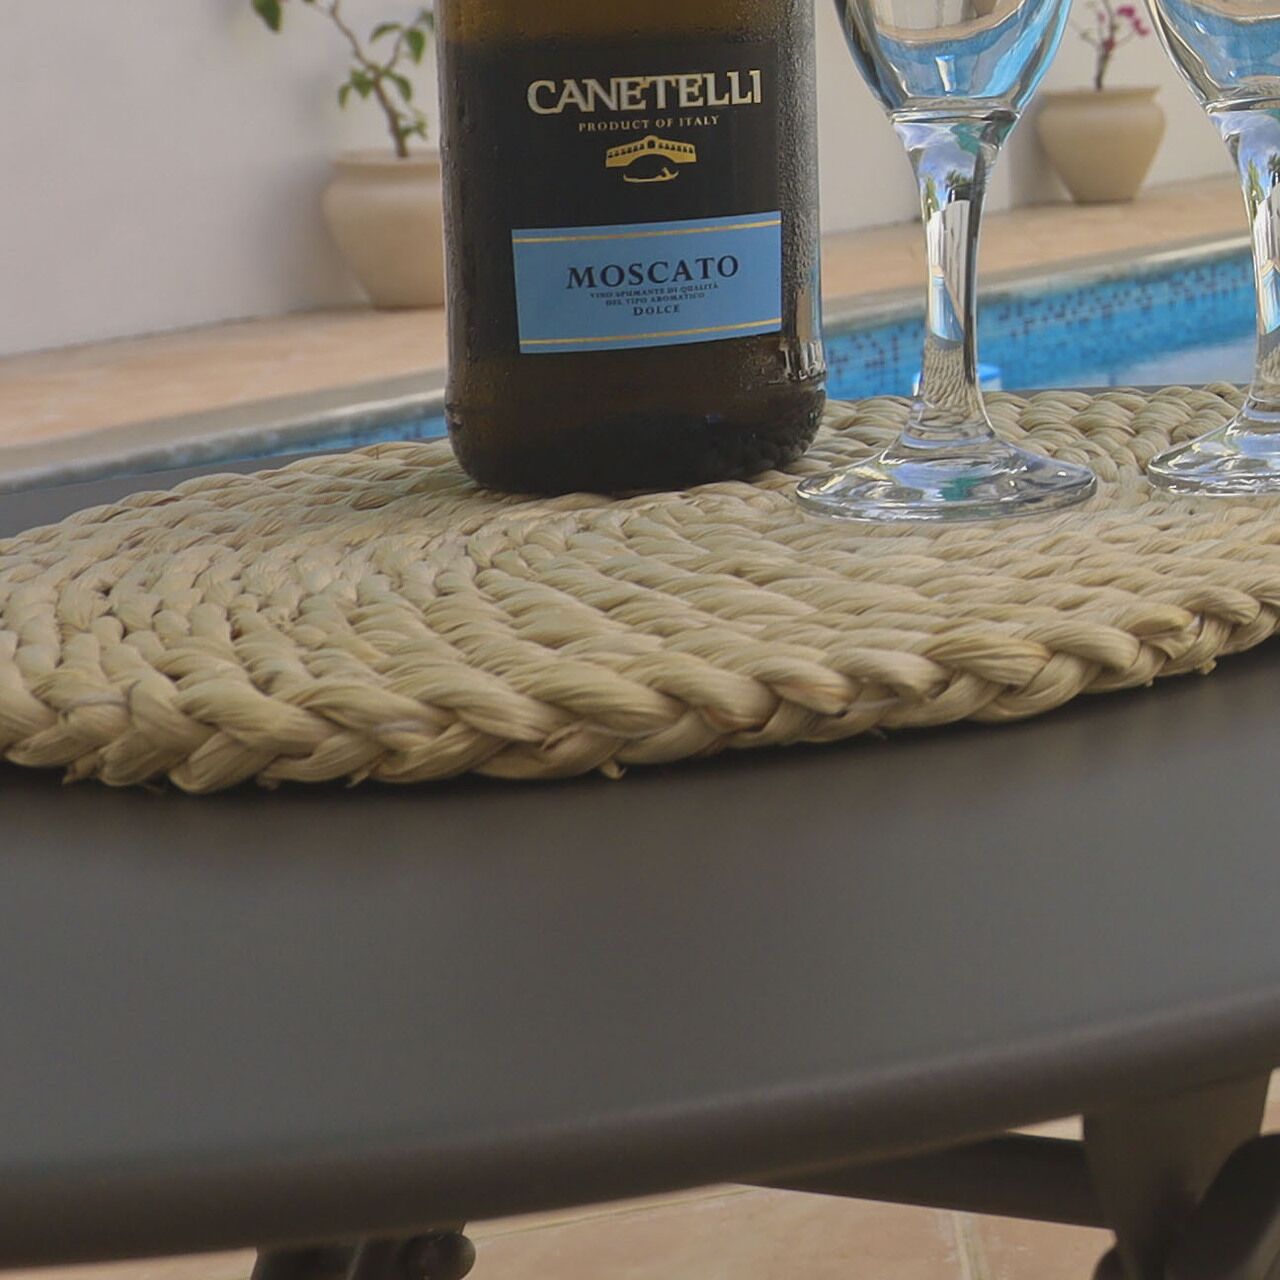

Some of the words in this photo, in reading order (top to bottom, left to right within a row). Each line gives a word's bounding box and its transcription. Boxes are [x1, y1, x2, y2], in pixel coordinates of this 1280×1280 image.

[526, 69, 762, 115] CANETELLI
[578, 119, 650, 133] PRODUCT
[655, 117, 673, 129] OF
[679, 114, 719, 128] ITALY
[565, 254, 739, 290] MOSCATO
[633, 304, 681, 316] DOLCE
